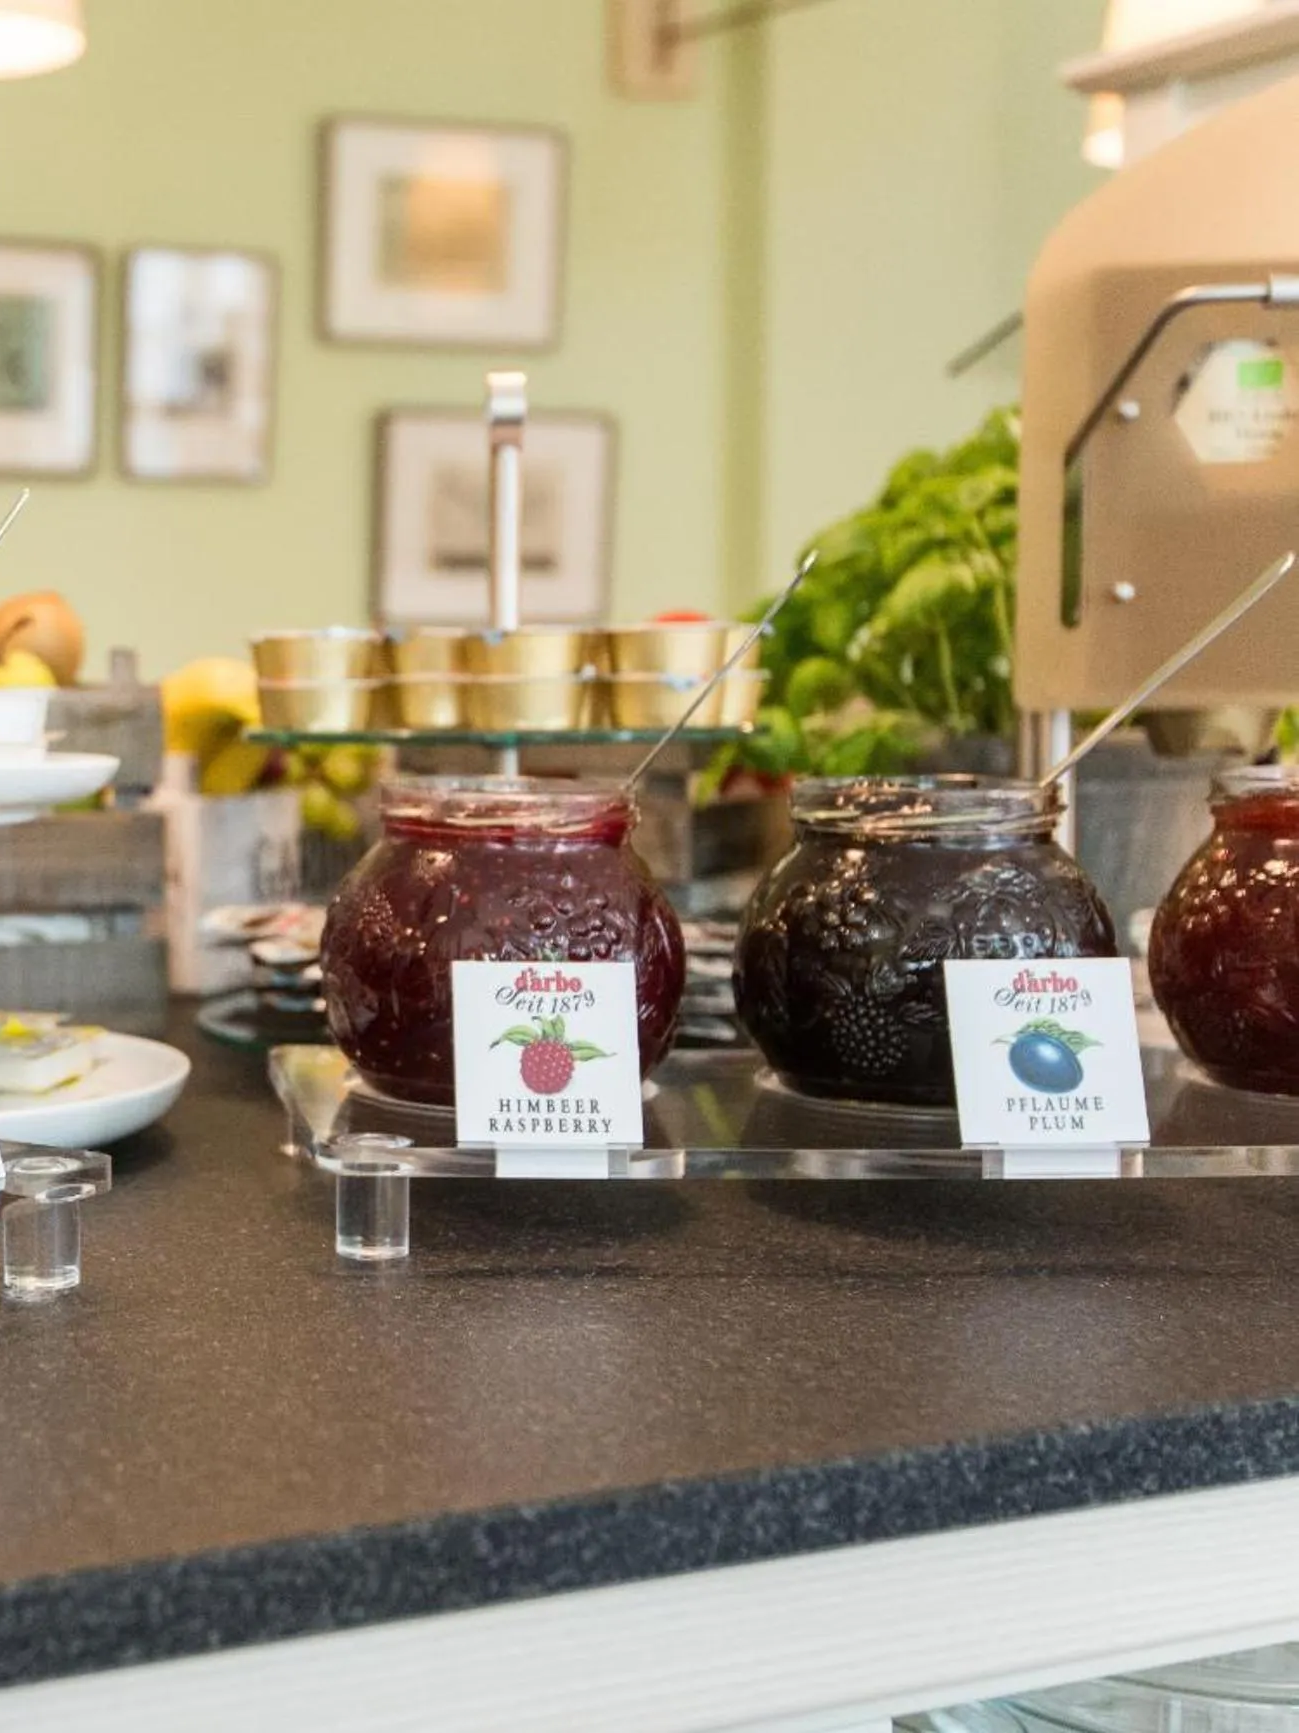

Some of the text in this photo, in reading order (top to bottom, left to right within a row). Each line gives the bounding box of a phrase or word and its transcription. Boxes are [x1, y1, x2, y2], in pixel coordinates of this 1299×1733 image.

[494, 986, 596, 1014] Seit 1879
[993, 986, 1093, 1014] Seit 1879
[499, 1098, 601, 1114] HIMBEER
[1006, 1095, 1105, 1112] PFLAUME
[488, 1117, 613, 1134] RASPBERRY
[1028, 1115, 1086, 1131] PLUM
